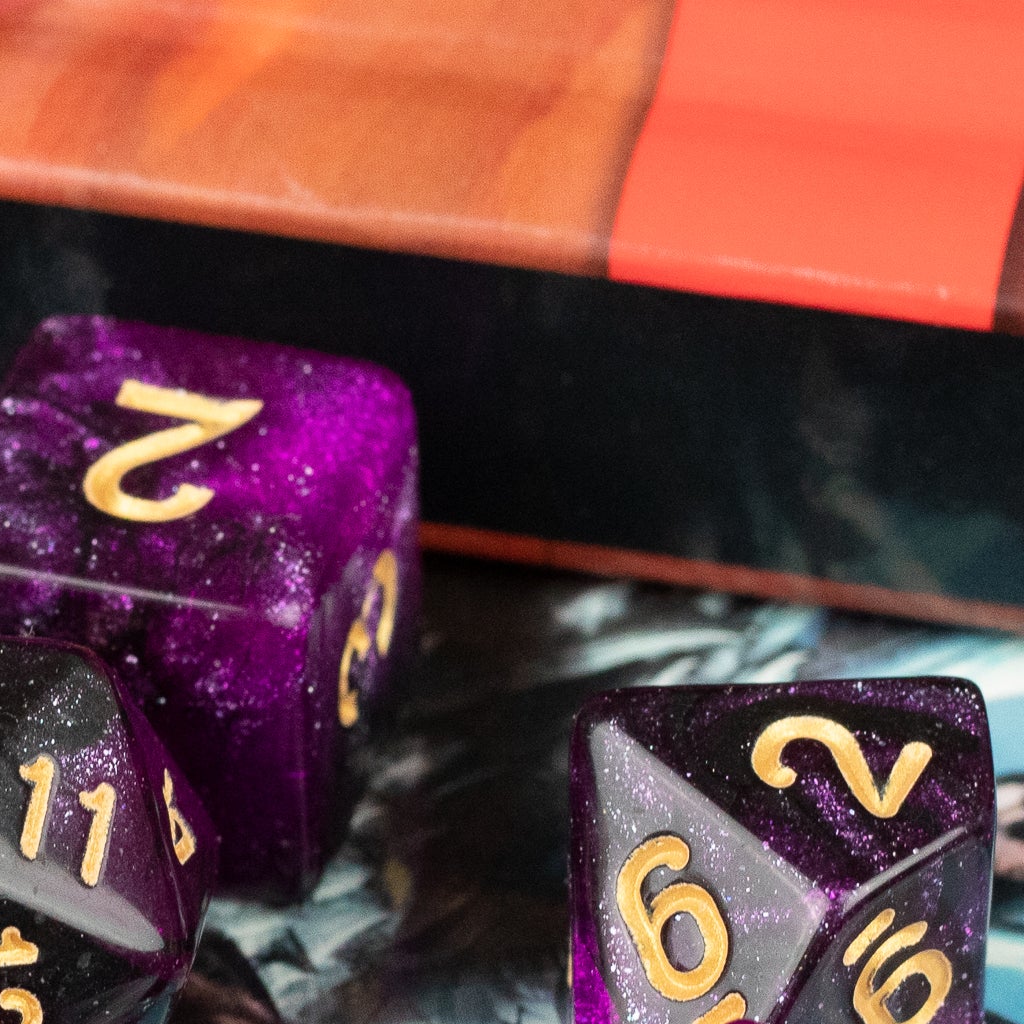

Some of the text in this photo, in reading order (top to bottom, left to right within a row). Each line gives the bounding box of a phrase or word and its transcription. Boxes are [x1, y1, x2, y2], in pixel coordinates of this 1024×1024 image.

[83, 379, 264, 523] 2
[19, 753, 117, 887] 11
[751, 715, 933, 818] 2
